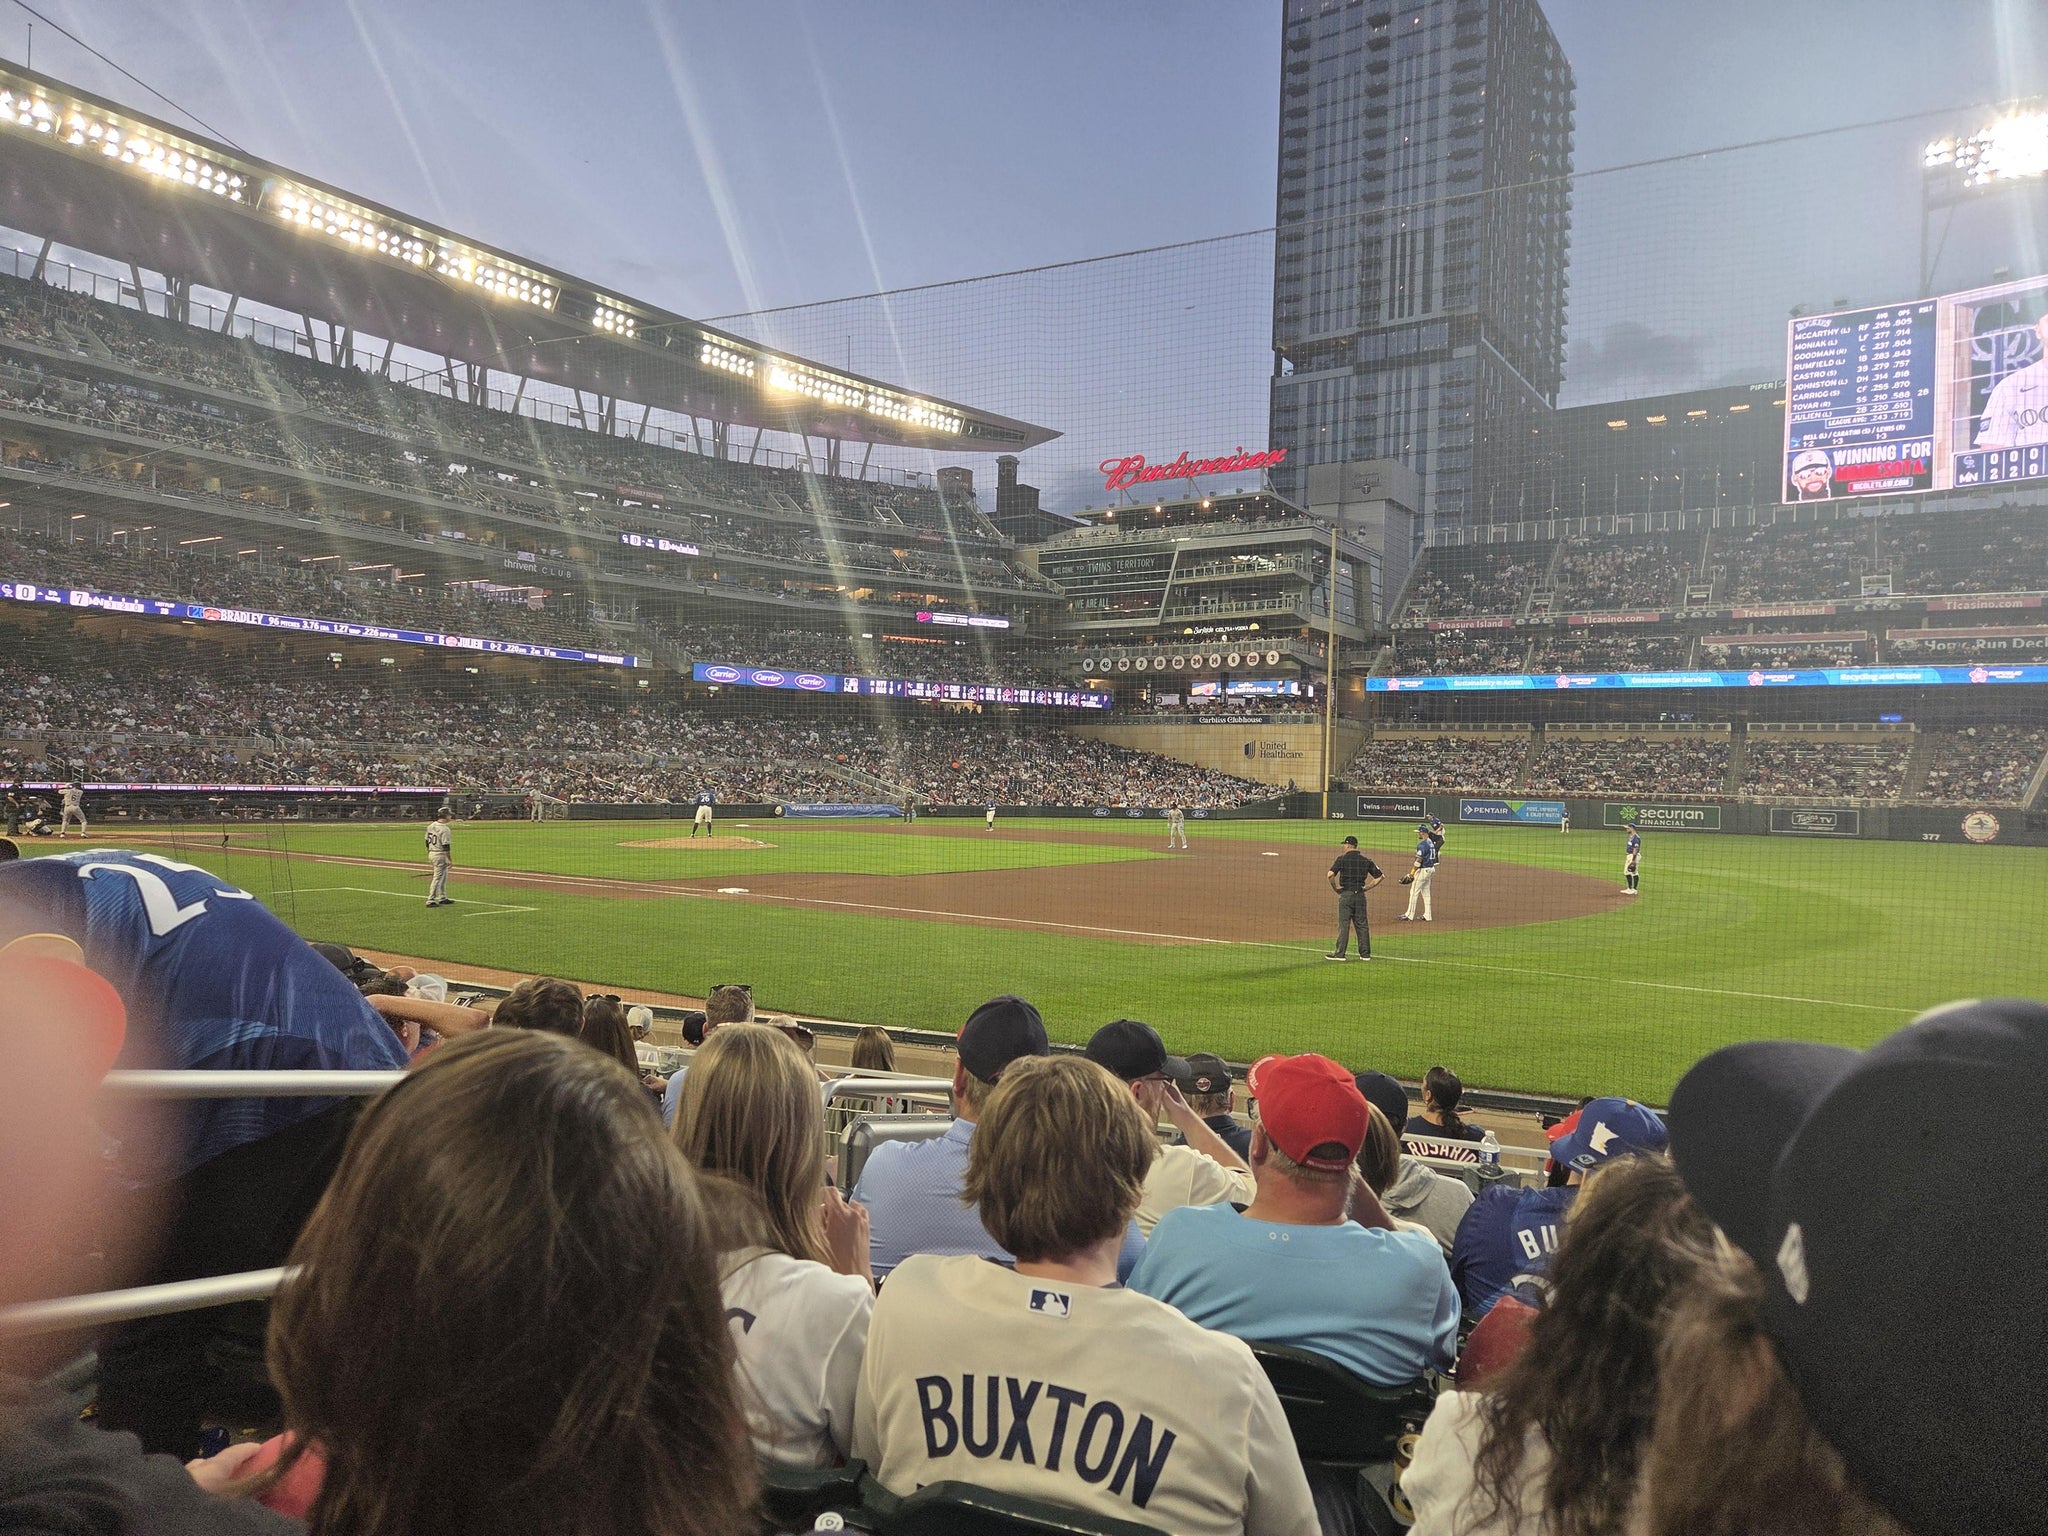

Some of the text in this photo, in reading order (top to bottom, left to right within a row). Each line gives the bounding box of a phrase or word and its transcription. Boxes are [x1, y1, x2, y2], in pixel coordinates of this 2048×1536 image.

[1794, 328, 1839, 341] MCCARTHY
[1794, 340, 1827, 351] MONIAK
[1794, 349, 1836, 361] GOODMAN
[1860, 344, 1866, 352] C
[1793, 359, 1834, 371] RUMFIELD
[1793, 370, 1826, 381] CASTRO
[1750, 382, 1773, 391] PIPER
[1793, 380, 1837, 392] JOHNSTON
[1856, 375, 1869, 383] DH
[1856, 386, 1868, 394] CF
[1793, 401, 1819, 411] TOVAR
[1792, 412, 1821, 422] JULIEN
[1828, 418, 1852, 427] LEAGUE
[1832, 441, 1931, 466] WINNING FOR
[1990, 448, 2038, 465] 0 0 0
[1099, 446, 1287, 491] Budweiser
[1989, 468, 1999, 480] 2
[2010, 465, 2019, 478] 2
[2029, 463, 2038, 475] 0
[504, 558, 572, 578] thrivent CLUB
[1088, 561, 1112, 573] TWINS
[1116, 558, 1156, 570] TERRITORY
[21, 586, 30, 599] 0
[76, 593, 84, 604] 7
[1074, 598, 1109, 609] WE ARE ALL
[1743, 607, 1826, 618] Treasure Island
[1437, 619, 1504, 630] Treasure Island
[220, 609, 264, 625] BRADLEY
[268, 616, 280, 626] 96
[280, 620, 300, 629] PITCHES
[302, 620, 320, 631] 3.76
[334, 624, 349, 633] 1.27
[362, 627, 379, 637] .226
[490, 643, 502, 651] 0-2
[505, 644, 519, 653] .220
[1976, 638, 2007, 650] Run
[710, 669, 737, 679] Carrier
[755, 673, 781, 683] Carrier
[799, 677, 823, 687] Carrier
[1199, 716, 1263, 724] Carbliss Clubhouse
[1260, 741, 1287, 750] United
[1260, 750, 1304, 759] Healthcare
[1474, 806, 1508, 815] PENTAIR
[1640, 807, 1704, 821] securian
[1640, 819, 1685, 827] FINANCIAL
[1820, 816, 1833, 824] TV
[428, 832, 438, 846] 50
[1921, 833, 1941, 841] 377
[1518, 1224, 1560, 1260] BU
[915, 1374, 1177, 1510] BUXTON
